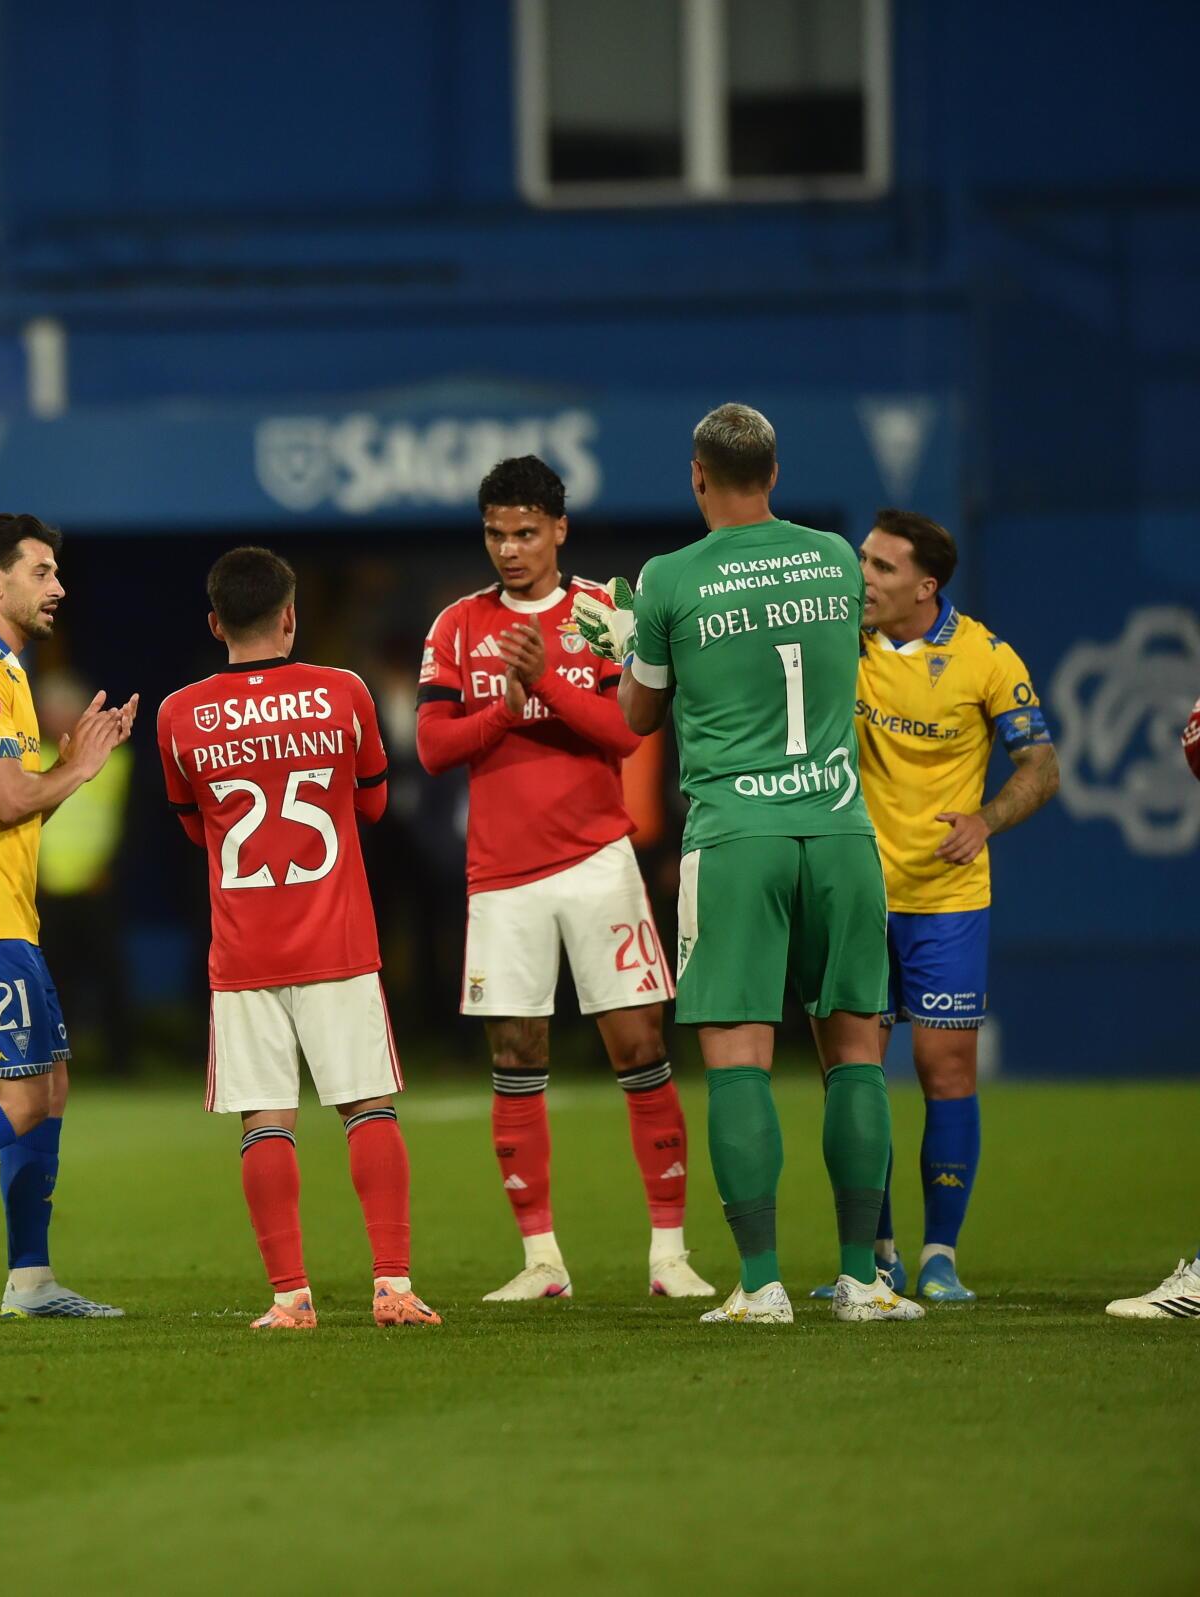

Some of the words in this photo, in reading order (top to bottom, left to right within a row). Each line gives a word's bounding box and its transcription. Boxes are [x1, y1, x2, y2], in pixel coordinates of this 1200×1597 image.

[699, 574, 779, 598] FINANCIAL
[783, 565, 843, 584] SERVICES
[718, 550, 821, 576] VOLKSWAGEN
[698, 607, 758, 649] JOEL
[765, 595, 849, 629] ROBLES
[223, 687, 332, 731] SAGRES
[773, 642, 808, 757] 1
[854, 699, 960, 739] SOLVERDE.PT
[192, 729, 344, 773] PRESTIANNI
[208, 767, 339, 889] 25
[610, 919, 657, 972] 20
